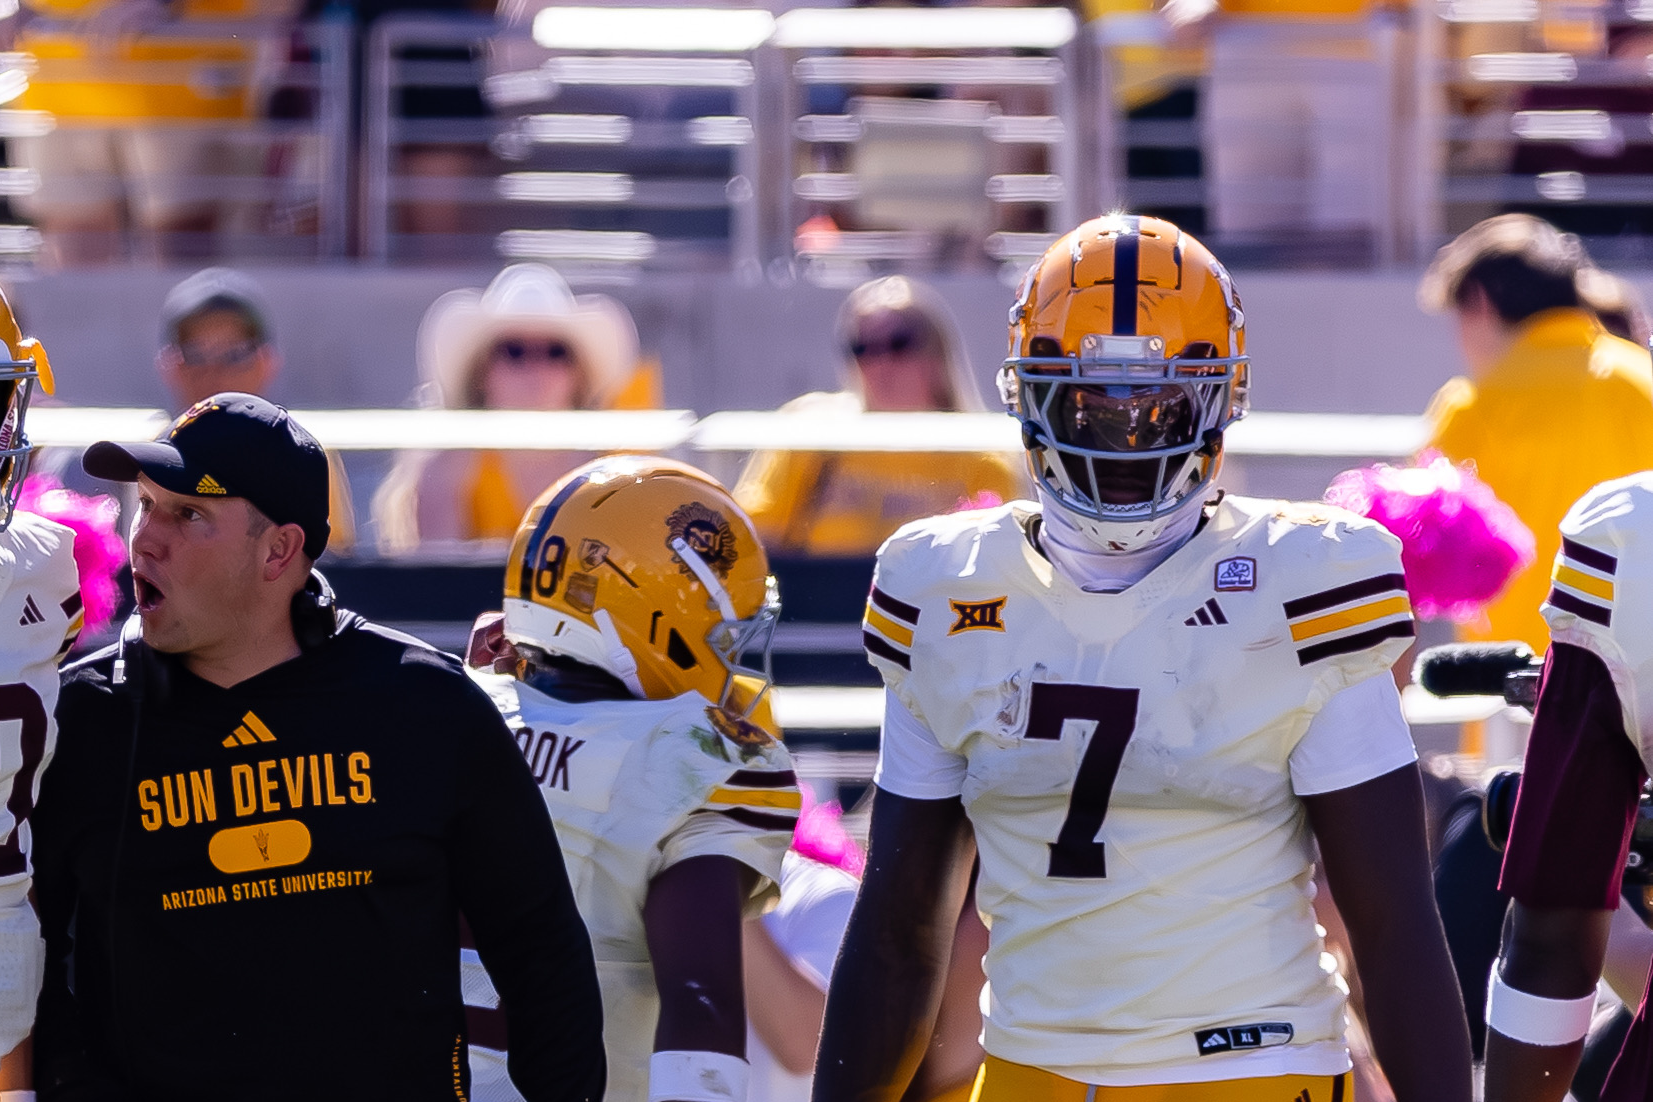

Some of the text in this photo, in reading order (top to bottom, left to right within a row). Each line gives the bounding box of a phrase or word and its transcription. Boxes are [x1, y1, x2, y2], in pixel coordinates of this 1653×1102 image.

[196, 486, 227, 494] adidas
[535, 534, 566, 597] 8
[948, 596, 1007, 636] XII
[138, 769, 217, 831] SUN
[1024, 682, 1140, 878] 7
[162, 886, 227, 911] ARIZONA
[232, 879, 278, 902] STATE
[1241, 1032, 1254, 1043] XL
